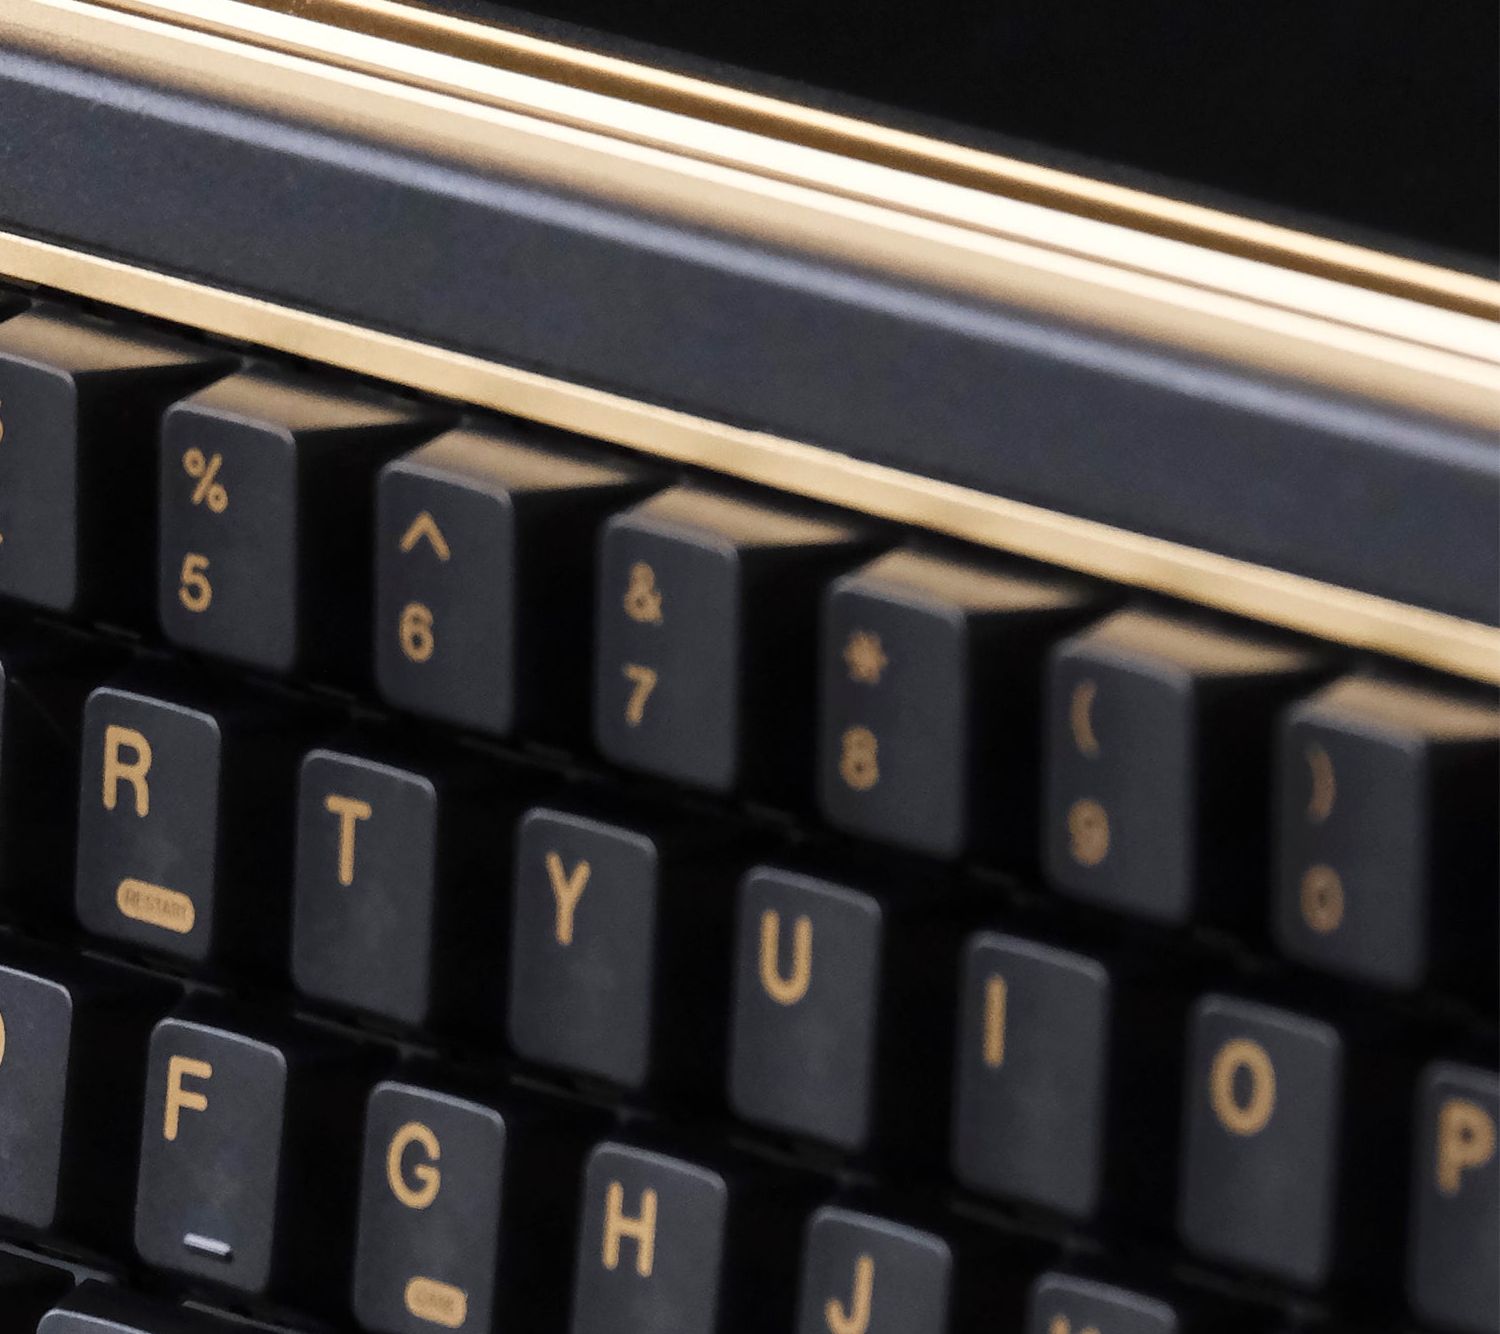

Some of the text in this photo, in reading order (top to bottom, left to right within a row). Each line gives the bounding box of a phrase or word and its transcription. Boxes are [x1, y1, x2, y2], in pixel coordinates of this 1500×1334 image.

[181, 446, 231, 515] %
[399, 510, 452, 561] ^
[179, 554, 213, 612] 5
[622, 561, 664, 624] &
[399, 603, 434, 662] 6
[624, 663, 659, 725] 7
[103, 724, 152, 817] R
[838, 725, 881, 791] 8
[325, 795, 372, 884] T
[1066, 798, 1111, 867] 9
[547, 853, 590, 944] Y
[760, 911, 812, 1004] U
[984, 977, 1006, 1065] I
[163, 1055, 213, 1140] F
[1211, 1039, 1275, 1134] O
[387, 1122, 440, 1209] G
[1438, 1100, 1495, 1190] P
[603, 1182, 657, 1276] H
